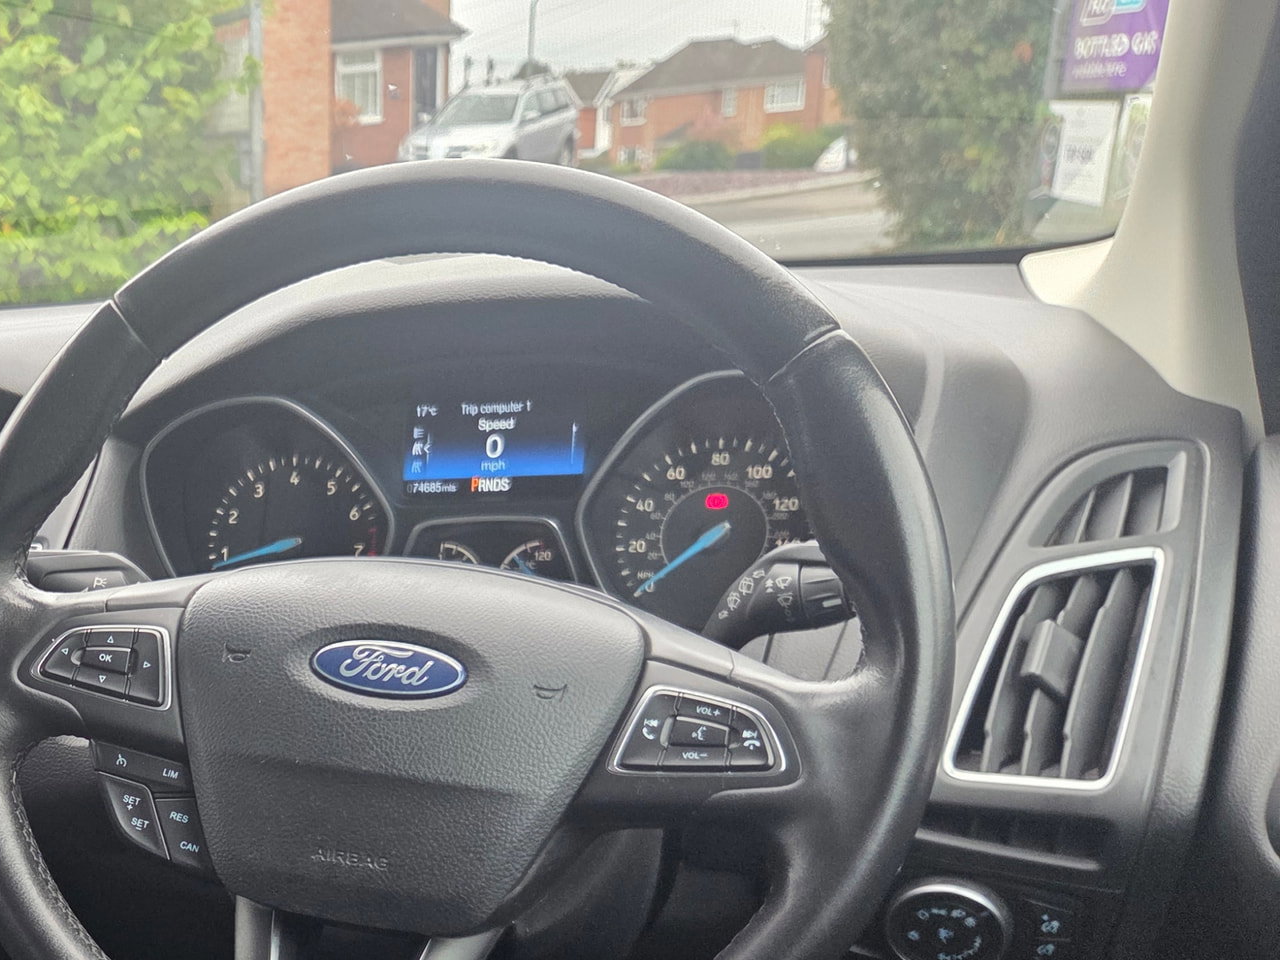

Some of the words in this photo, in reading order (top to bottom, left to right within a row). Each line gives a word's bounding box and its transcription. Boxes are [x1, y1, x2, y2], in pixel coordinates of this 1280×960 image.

[460, 402, 480, 416] Trip
[480, 401, 523, 414] computer
[477, 417, 517, 432] Speed
[485, 433, 506, 459] 0
[480, 460, 506, 472] mph
[711, 452, 730, 466] 80
[289, 471, 300, 486] 4
[666, 466, 686, 480] 60
[746, 465, 773, 479] 100
[254, 484, 265, 498] 3
[326, 481, 337, 496] 5
[636, 498, 654, 512] 40
[773, 497, 799, 511] 120
[228, 511, 238, 524] 2
[349, 506, 360, 521] 6
[628, 540, 646, 553] 20
[534, 551, 552, 561] 120
[99, 653, 113, 662] OK
[339, 644, 435, 686] Ford
[163, 768, 179, 779] LIM
[122, 794, 141, 806] SET
[131, 817, 150, 829] SET
[169, 811, 189, 824] RES
[180, 841, 200, 853] CAN
[311, 849, 388, 871] AIRBAG
